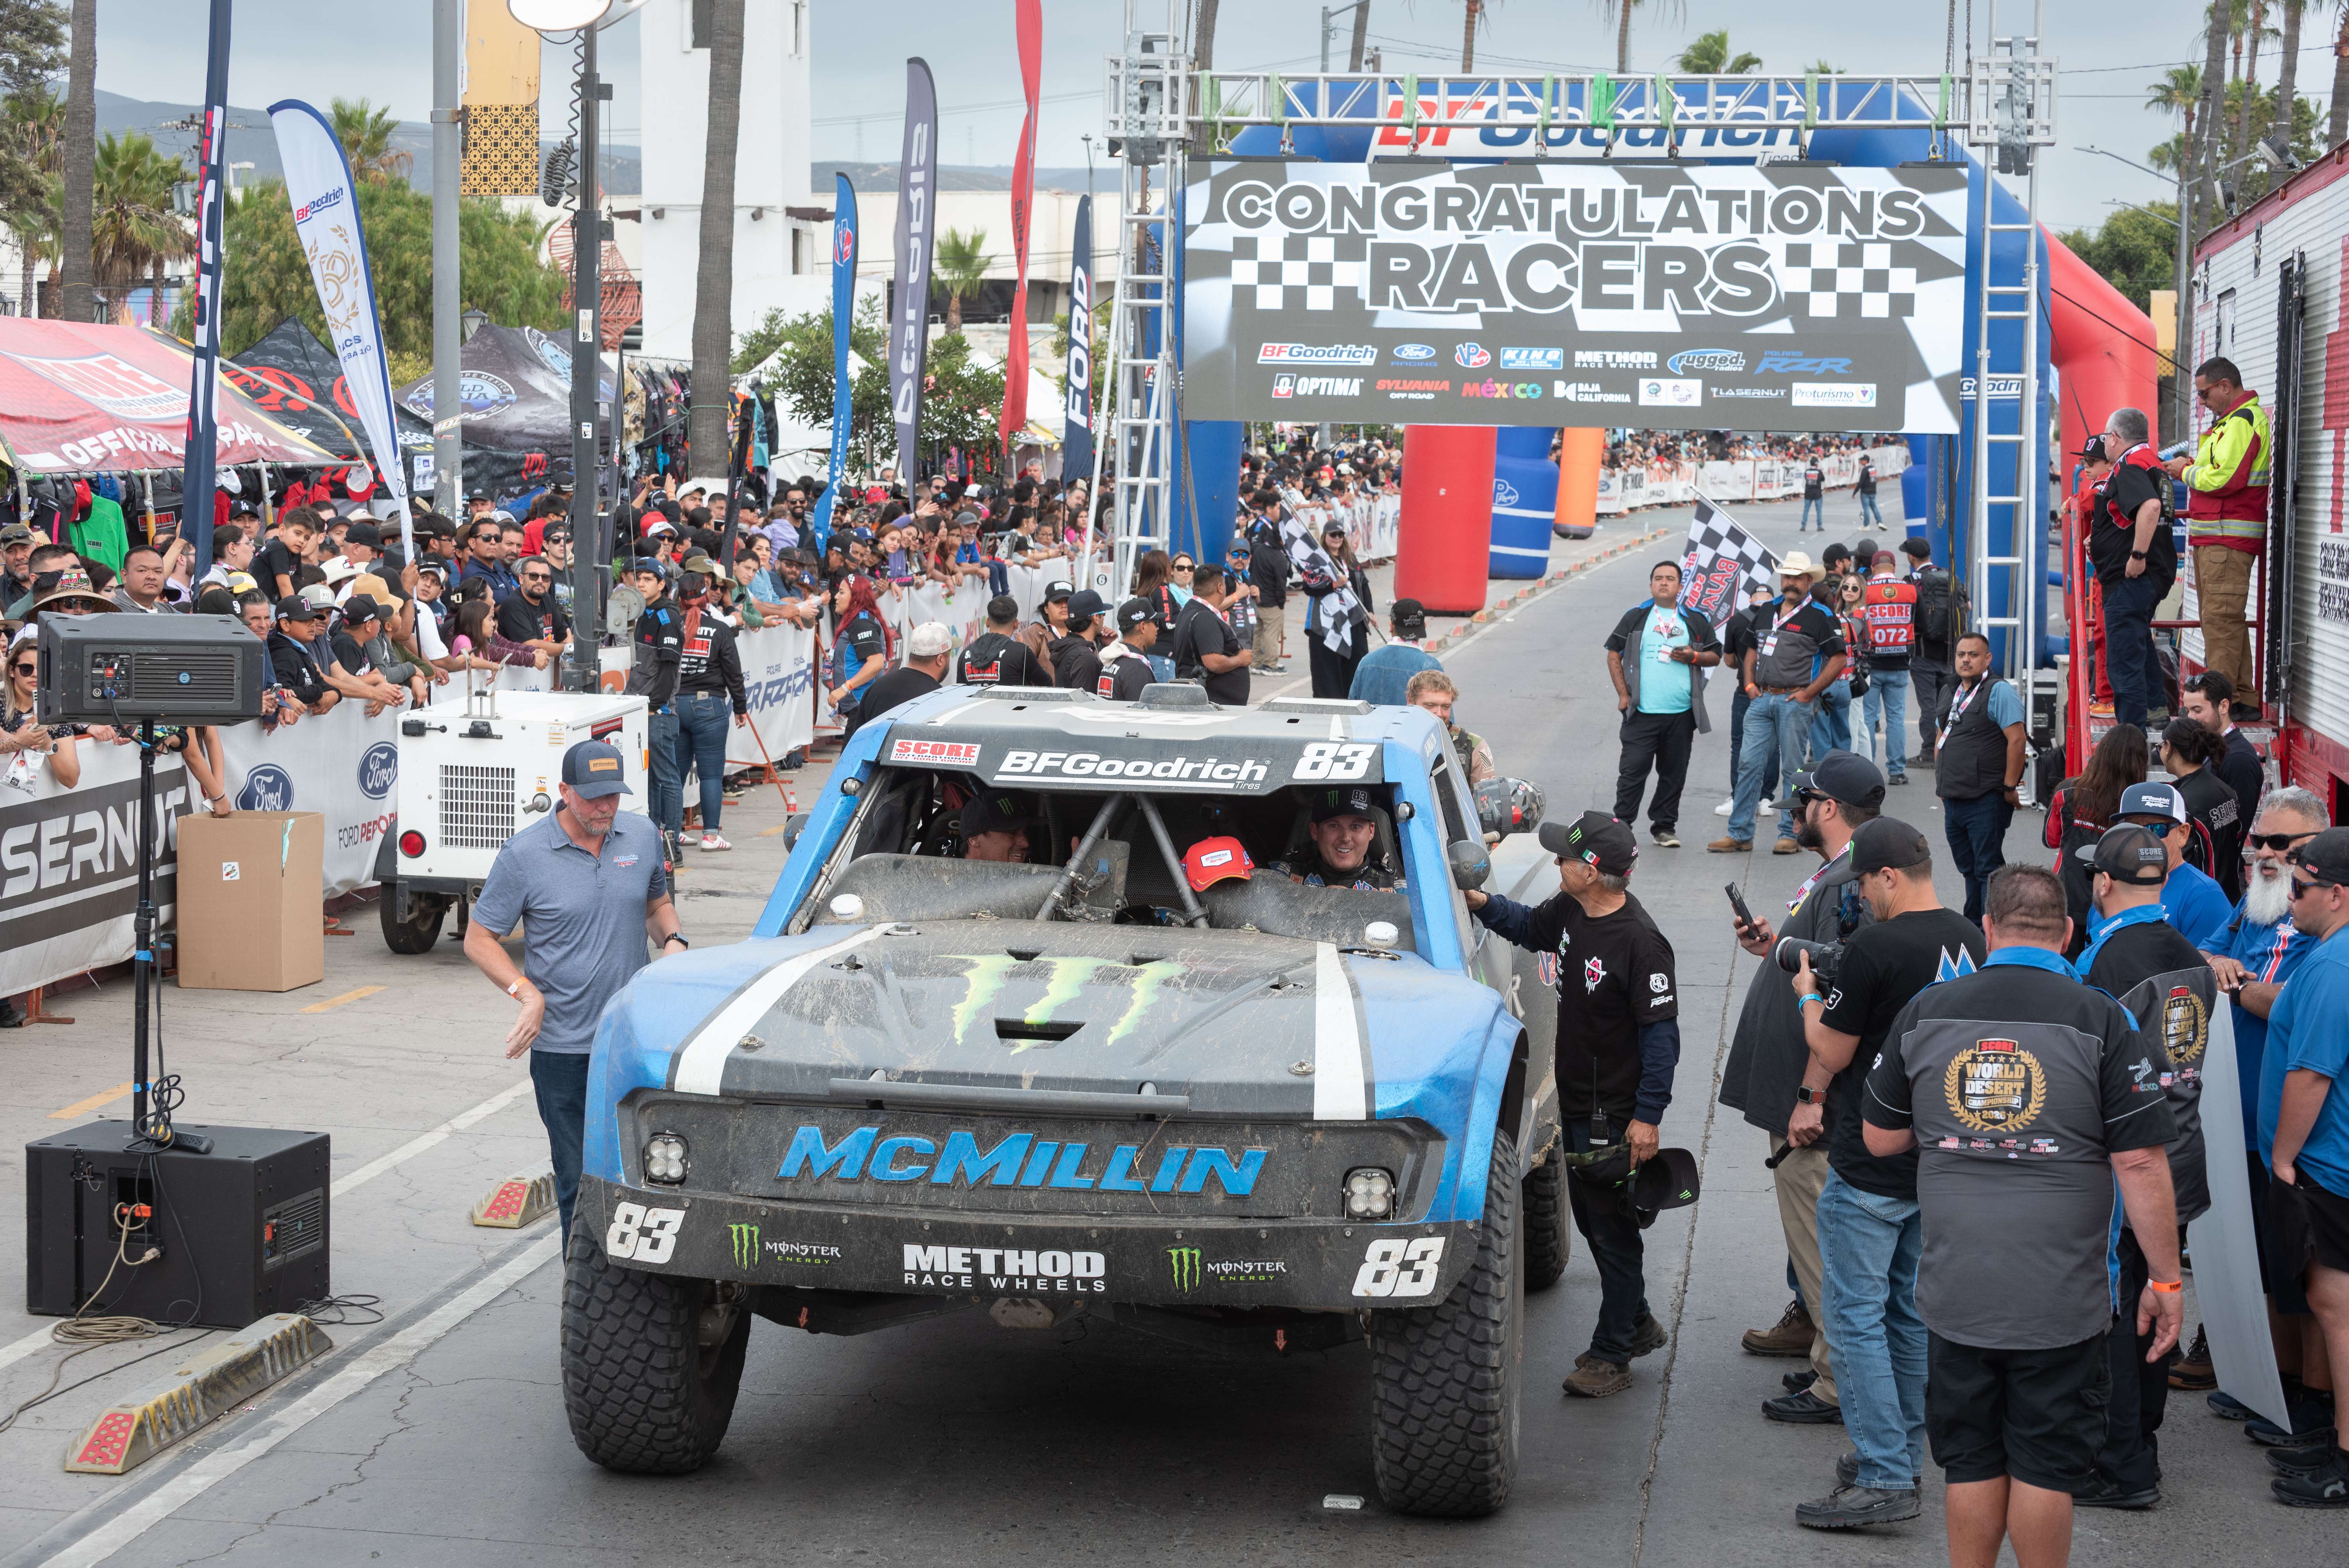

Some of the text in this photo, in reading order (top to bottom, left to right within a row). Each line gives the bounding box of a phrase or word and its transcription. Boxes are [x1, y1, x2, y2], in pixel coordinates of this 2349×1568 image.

[1223, 181, 1924, 240] CONGRATULATIONS
[1366, 239, 1776, 315] RACERS
[1068, 265, 1088, 428] FORD
[1262, 345, 1374, 359] BFGoodrich
[1402, 346, 1428, 357] Ford
[1456, 343, 1479, 365] VP
[1504, 349, 1561, 360] KING
[1575, 351, 1657, 363] METHOD
[1754, 357, 1853, 375] RZR
[481, 374, 510, 392] MEXICO
[1296, 377, 1360, 396] OPTIMA
[1376, 379, 1449, 391] SYLVANIA
[1577, 383, 1601, 392] BAJA
[1577, 394, 1631, 403] CALIFORNIA
[1795, 388, 1854, 398] Proturismo
[61, 427, 186, 465] OFFICIAL
[2086, 438, 2097, 451] 1
[240, 500, 250, 510] LA
[803, 574, 811, 584] LA
[301, 598, 311, 611] 1
[1869, 605, 1909, 618] SCORE
[663, 637, 678, 645] STAFF
[857, 630, 872, 640] STAFF
[1875, 628, 1907, 643] 072
[896, 741, 977, 758] SCORE
[998, 750, 1267, 780] BFGoodrich
[1292, 743, 1377, 779] 83
[366, 751, 397, 789] Ford
[1234, 781, 1261, 789] Tires
[253, 774, 283, 812] Ford
[1351, 789, 1367, 802] 83
[2209, 799, 2237, 823] SCORE
[0, 785, 186, 899] SERNUT
[339, 825, 359, 850] FORD
[1205, 852, 1228, 862] BFGoodrich
[1650, 995, 1673, 1008] RZR
[2167, 1005, 2194, 1020] WORLD
[2167, 1020, 2194, 1035] DESERT
[1981, 1041, 2014, 1052] SCORE
[1966, 1062, 2025, 1079] WORLD
[1965, 1080, 2025, 1095] DESERT
[1968, 1097, 2019, 1105] CHAMPIONSHIP
[1982, 1110, 2006, 1119] 2026
[606, 1202, 686, 1264] 83
[765, 1240, 842, 1257] MONSTER
[778, 1256, 830, 1265] ENERGY
[903, 1244, 1106, 1278] METHOD
[1207, 1260, 1287, 1275] MONSTER
[1352, 1237, 1446, 1297] 83
[904, 1273, 1105, 1293] RACE WHEELS
